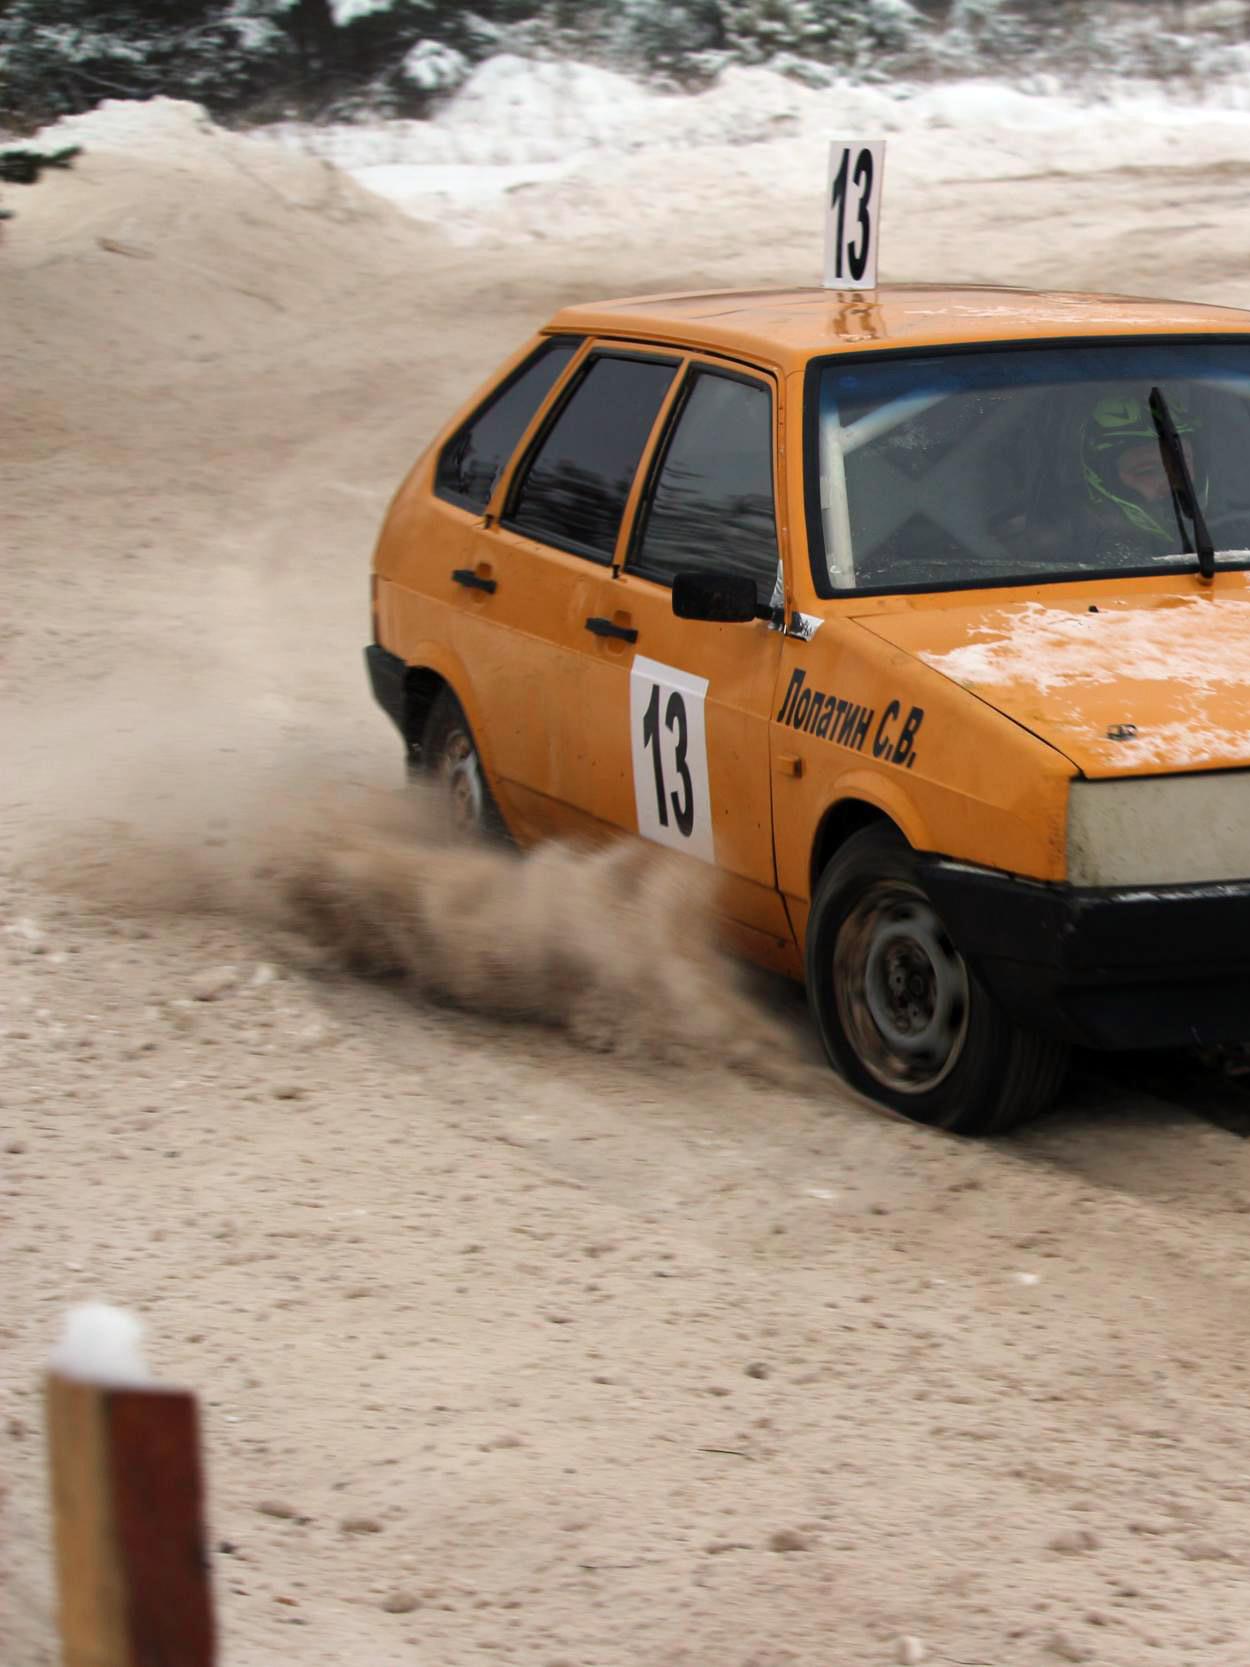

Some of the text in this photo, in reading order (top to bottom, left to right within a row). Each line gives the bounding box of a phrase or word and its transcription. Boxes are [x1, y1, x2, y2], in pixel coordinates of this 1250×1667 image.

[831, 148, 873, 281] 13
[643, 684, 694, 838] 13
[776, 668, 925, 768] Лопатин С.В.
